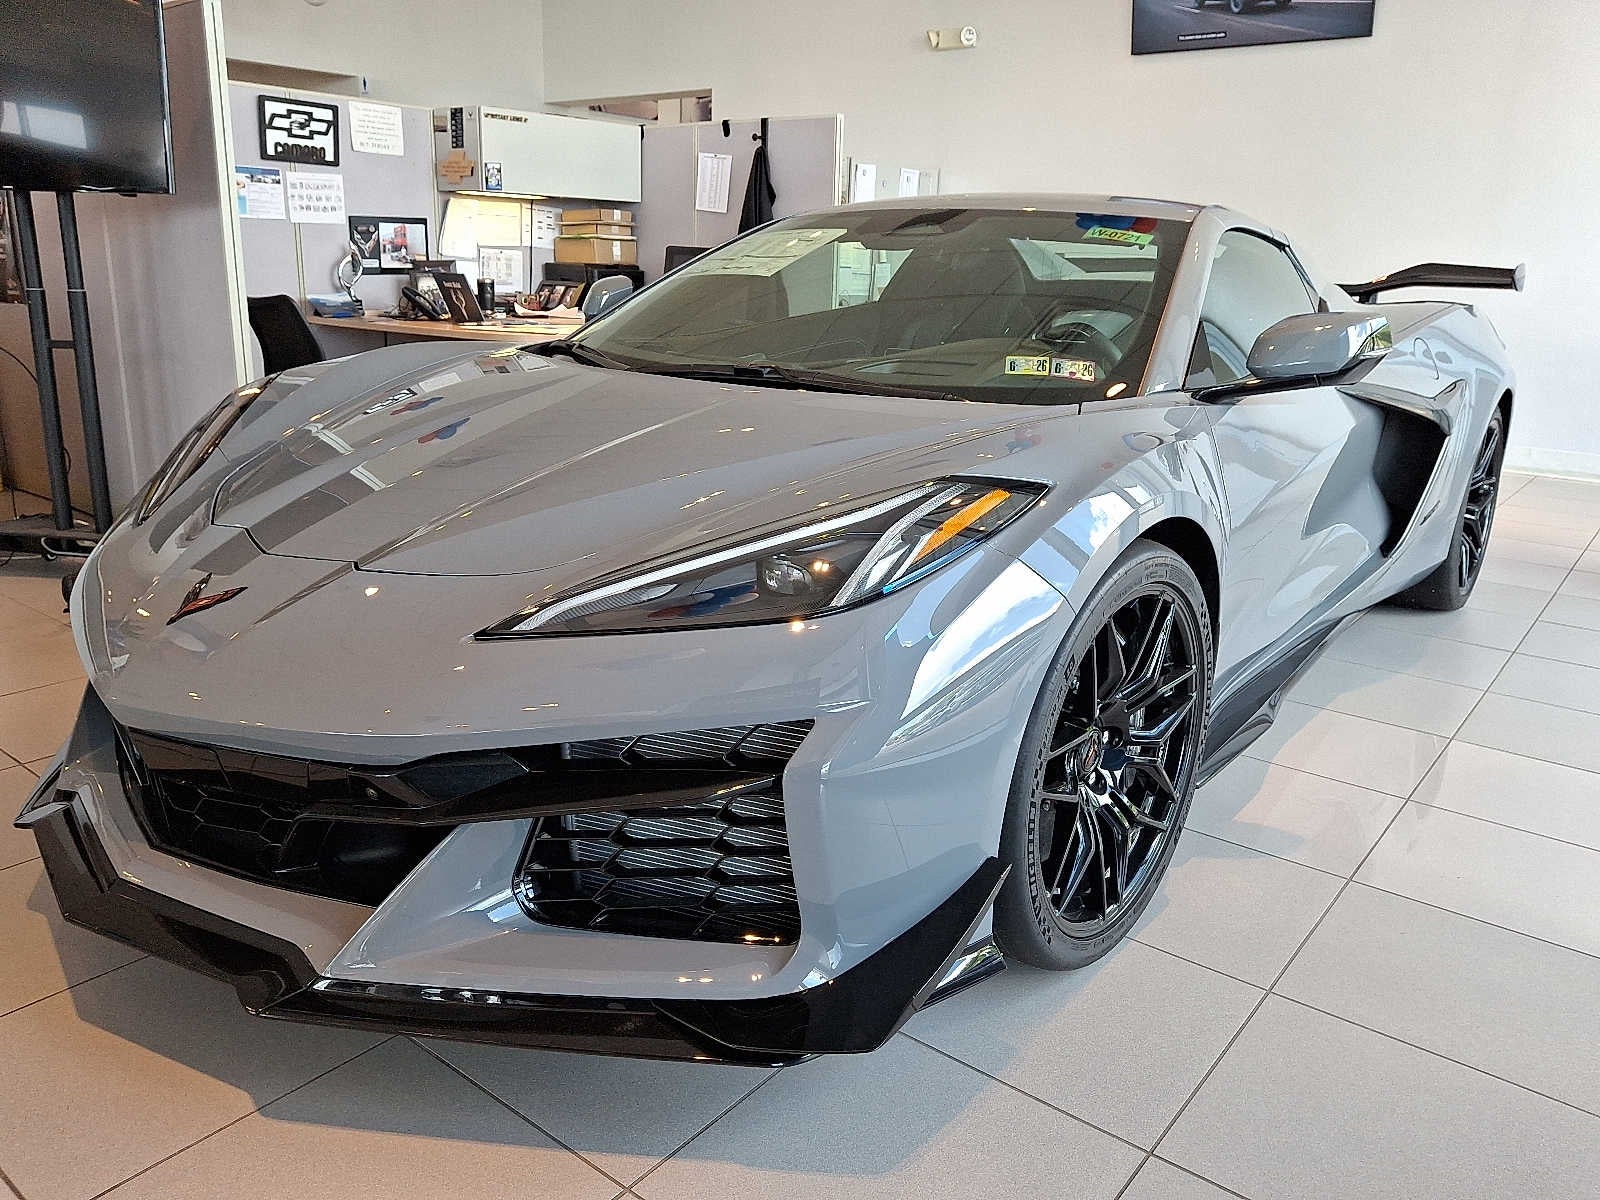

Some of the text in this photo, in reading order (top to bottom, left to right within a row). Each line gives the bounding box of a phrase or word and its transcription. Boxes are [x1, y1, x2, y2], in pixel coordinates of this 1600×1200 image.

[1036, 359, 1048, 372] 26
[1081, 363, 1093, 377] 26
[1027, 802, 1039, 899] MICHELIN
